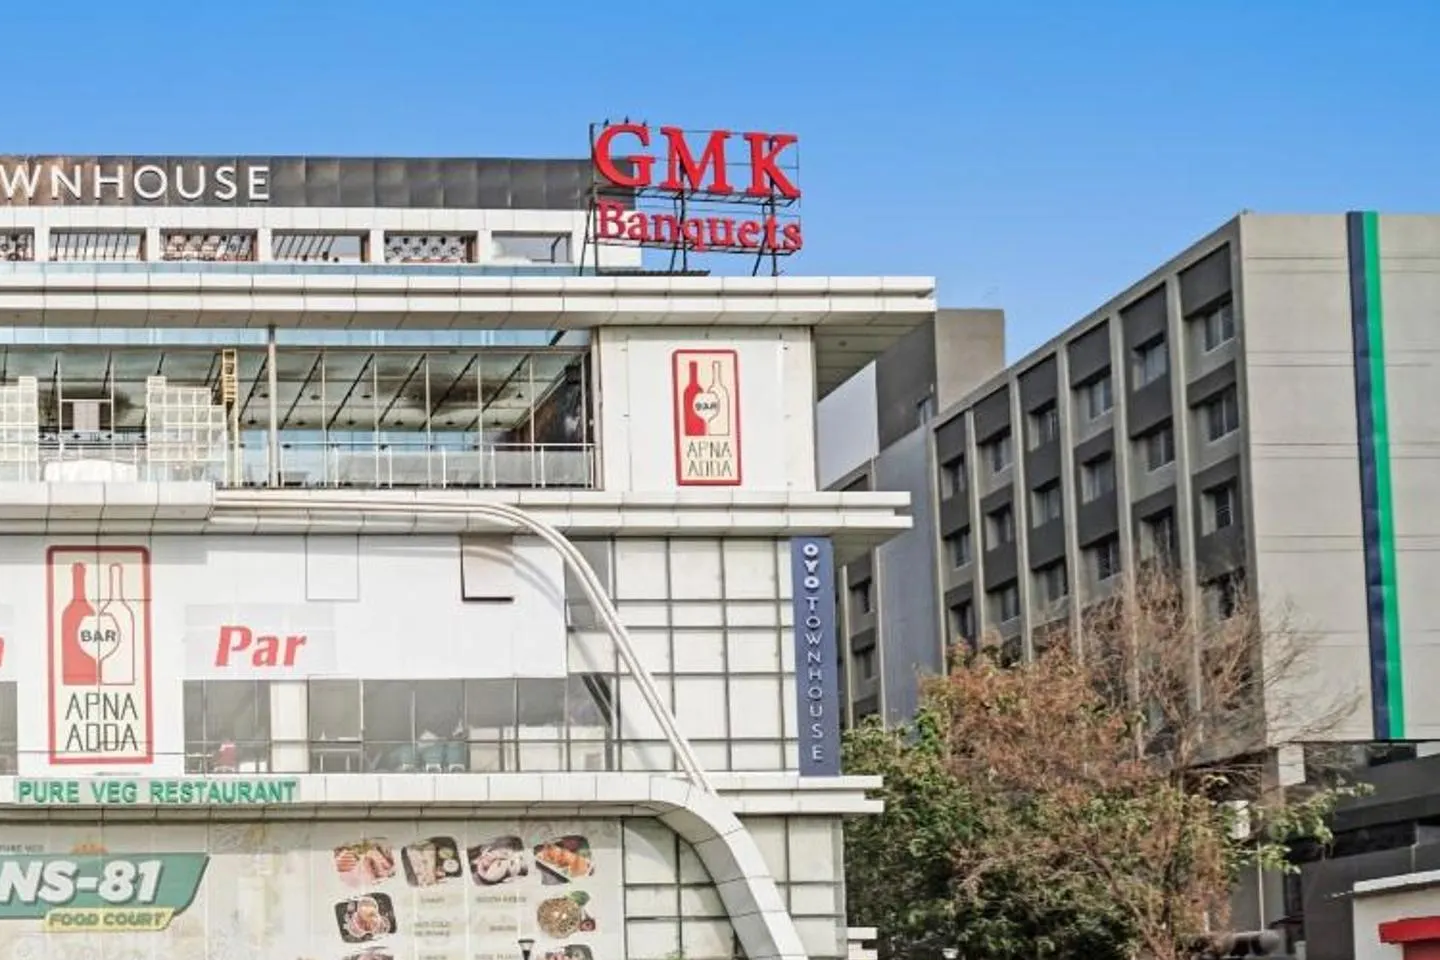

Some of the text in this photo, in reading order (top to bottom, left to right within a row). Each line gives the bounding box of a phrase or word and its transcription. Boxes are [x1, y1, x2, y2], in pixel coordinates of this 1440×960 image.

[594, 123, 801, 199] GMK
[594, 198, 803, 252] Banquets
[687, 441, 732, 458] APNA
[80, 629, 117, 642] BAR
[213, 624, 307, 669] Par
[802, 542, 825, 762] OYO TOWNHOUSE
[65, 692, 139, 721] APNA
[65, 723, 139, 753] ADDA
[18, 780, 297, 804] PURE VEG RESTAURANT
[48, 911, 167, 927] FOOD COURT
